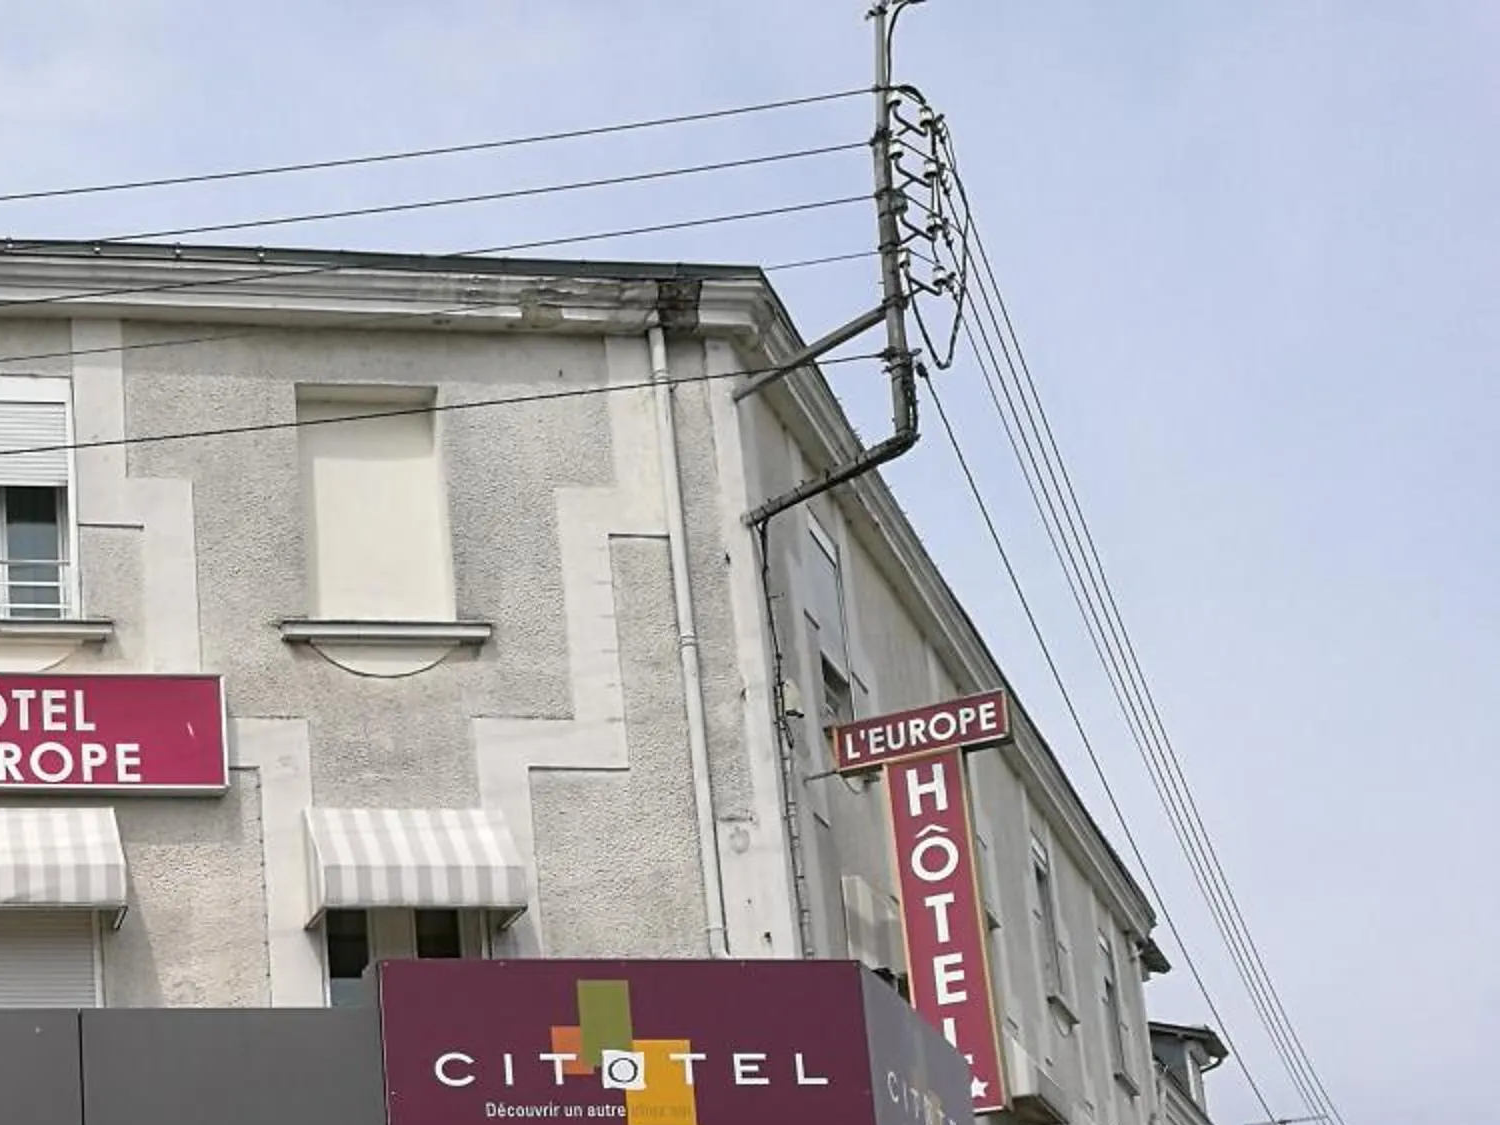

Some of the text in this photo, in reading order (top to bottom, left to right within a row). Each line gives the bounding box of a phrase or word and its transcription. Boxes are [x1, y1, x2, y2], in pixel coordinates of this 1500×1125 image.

[844, 701, 998, 760] L'EUROPE
[433, 1049, 830, 1090] CITOTEL
[485, 1101, 560, 1118] Découvrir
[563, 1104, 583, 1118] un
[587, 1103, 627, 1118] autre
